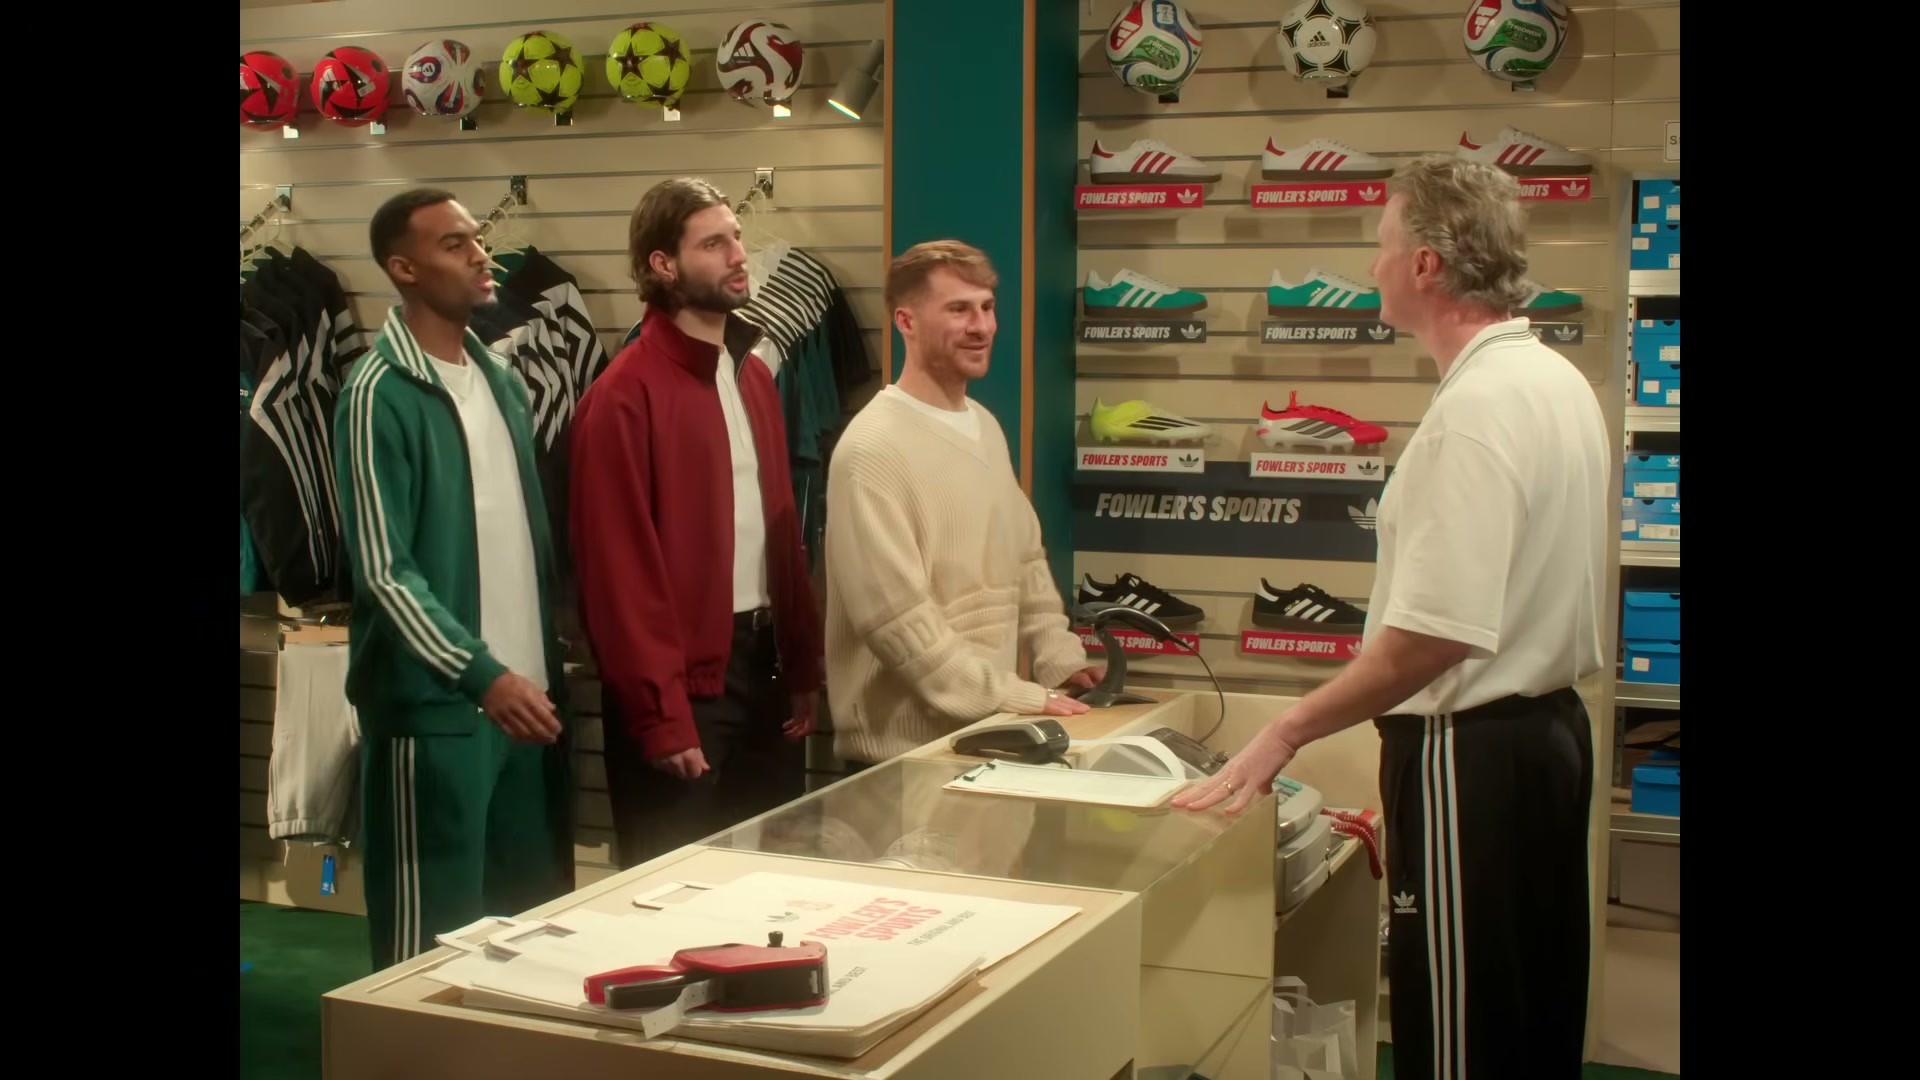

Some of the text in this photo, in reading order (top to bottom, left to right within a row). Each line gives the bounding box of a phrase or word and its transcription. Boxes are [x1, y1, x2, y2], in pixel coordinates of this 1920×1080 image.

[1080, 192, 1167, 205] FOWLER'S SPORTS
[1256, 189, 1348, 204] FOWLER'S SPORTS
[1084, 326, 1171, 339] FOWLER'S SPORTS
[1265, 327, 1358, 340] FOWLER'S SPORTS
[1082, 453, 1168, 467] FOWLER'S SPORTS
[1256, 459, 1346, 474] FOWLER'S SPORTS
[1095, 493, 1301, 524] FOWLER'S SPORTS
[1246, 637, 1336, 654] FOWLER'S SPORTS
[805, 897, 910, 939] FOWLER'S
[855, 906, 942, 940] SPORTS
